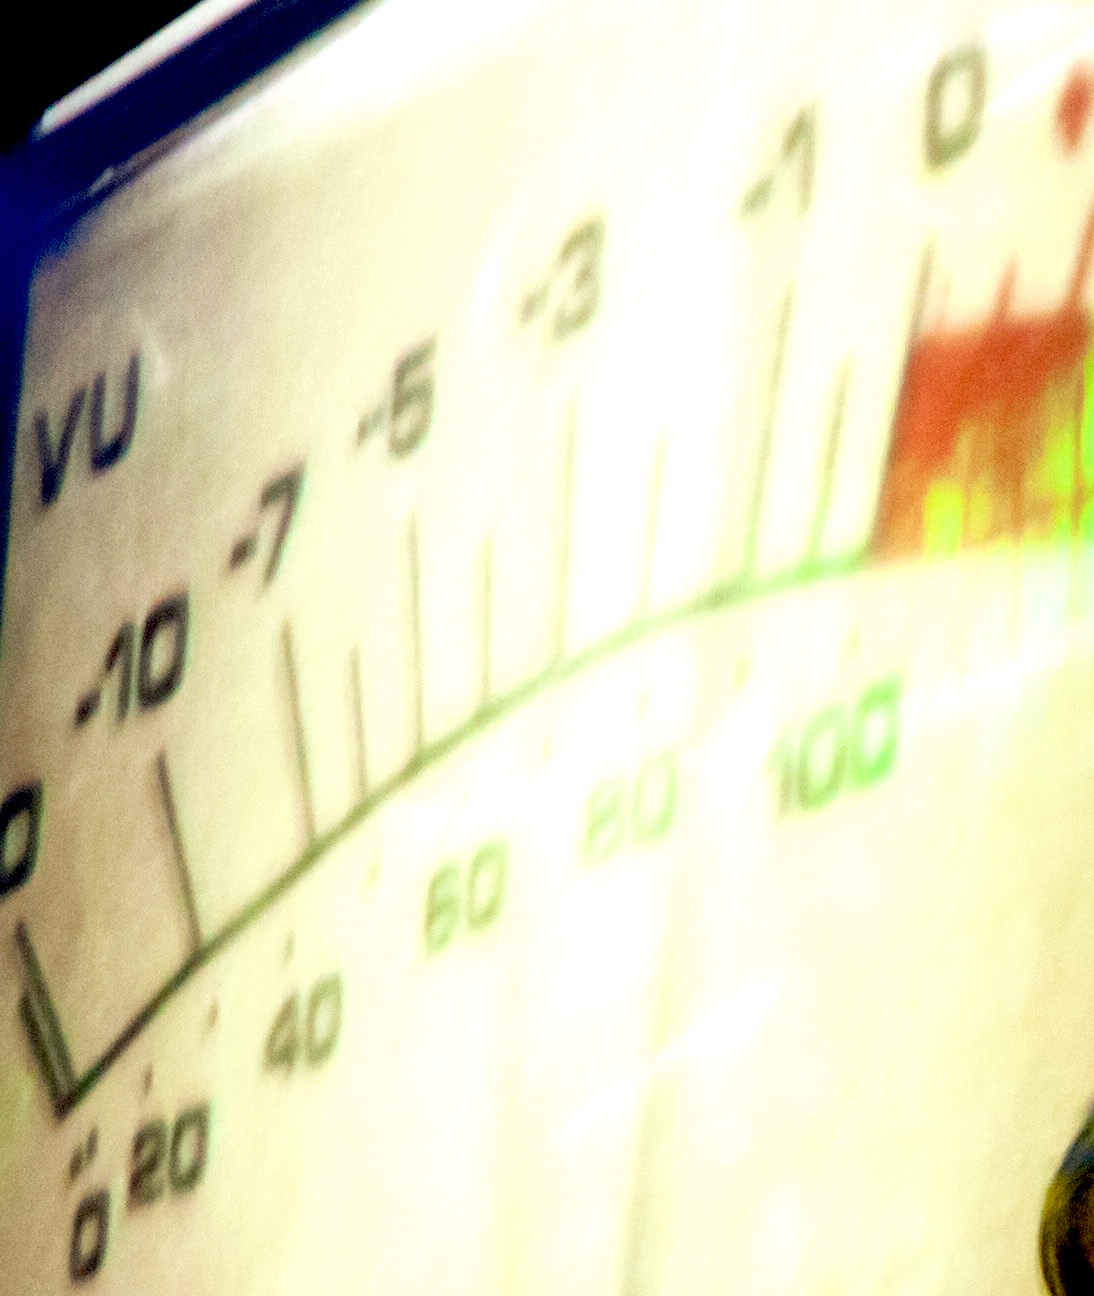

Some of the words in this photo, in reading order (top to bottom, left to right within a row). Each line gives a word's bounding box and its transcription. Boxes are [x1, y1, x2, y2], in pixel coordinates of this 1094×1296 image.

[33, 352, 141, 513] VU
[74, 590, 190, 729] -10
[227, 460, 308, 590] -7
[355, 333, 438, 462] -5
[518, 212, 606, 343] -3
[740, 100, 817, 216] -1
[925, 43, 988, 170] 0
[70, 1190, 111, 1284] 0
[127, 1105, 210, 1208] 20
[264, 974, 344, 1076] 40
[768, 676, 902, 817] 100
